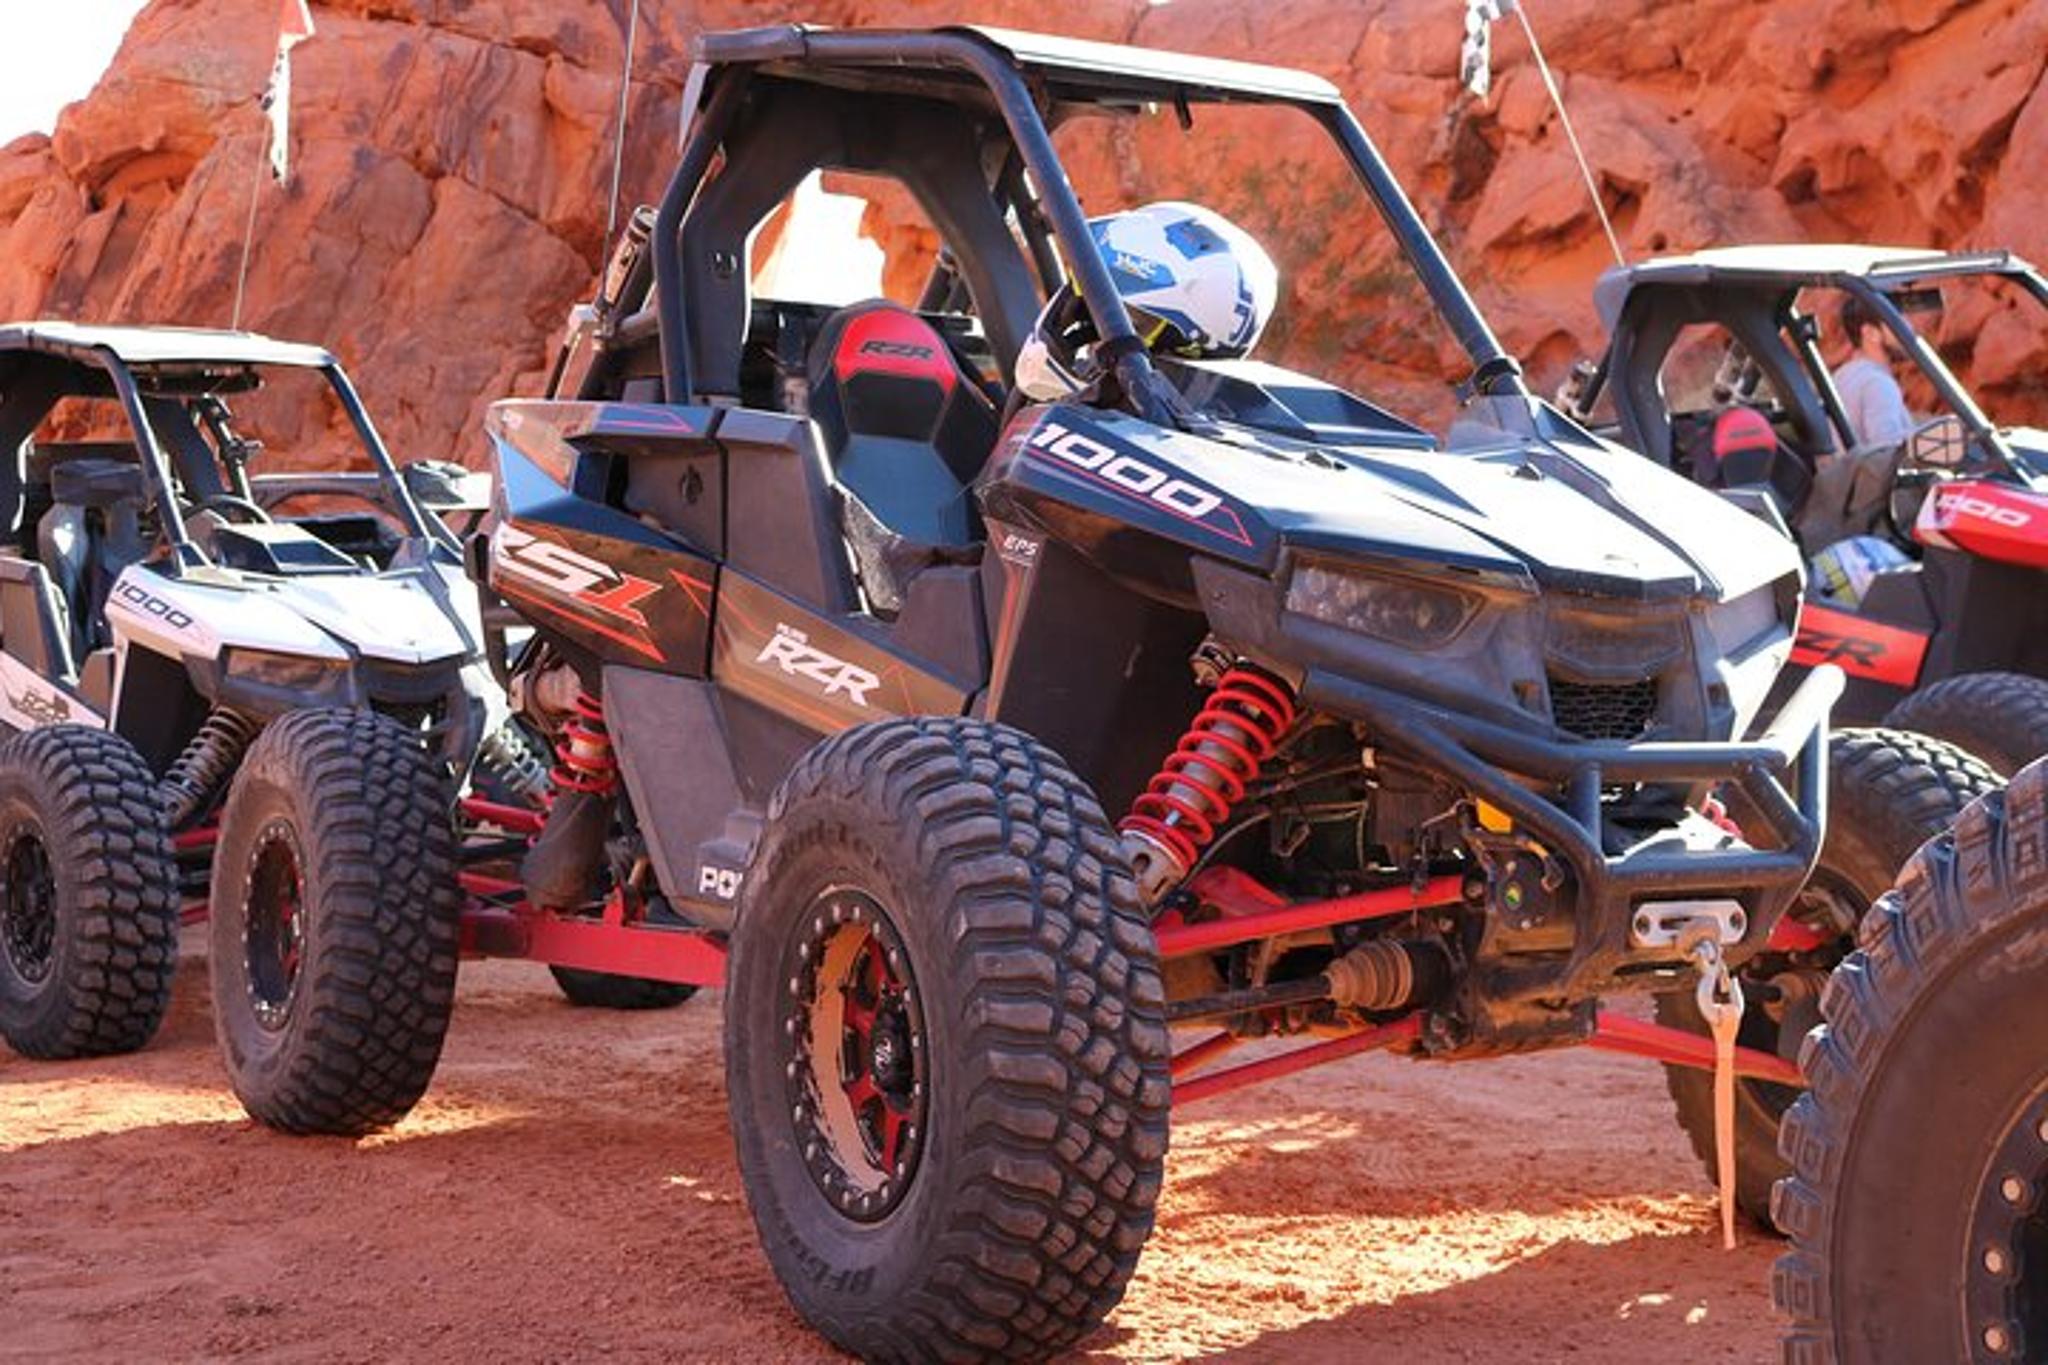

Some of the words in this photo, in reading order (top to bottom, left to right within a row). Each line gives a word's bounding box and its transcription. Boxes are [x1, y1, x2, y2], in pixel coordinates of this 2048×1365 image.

[861, 341, 934, 358] RZR
[1031, 423, 1223, 517] 1000
[1003, 534, 1039, 556] EPS
[116, 580, 194, 629] 1000
[1795, 628, 1888, 669] ZR
[755, 633, 880, 707] RZR
[699, 866, 743, 899] PO
